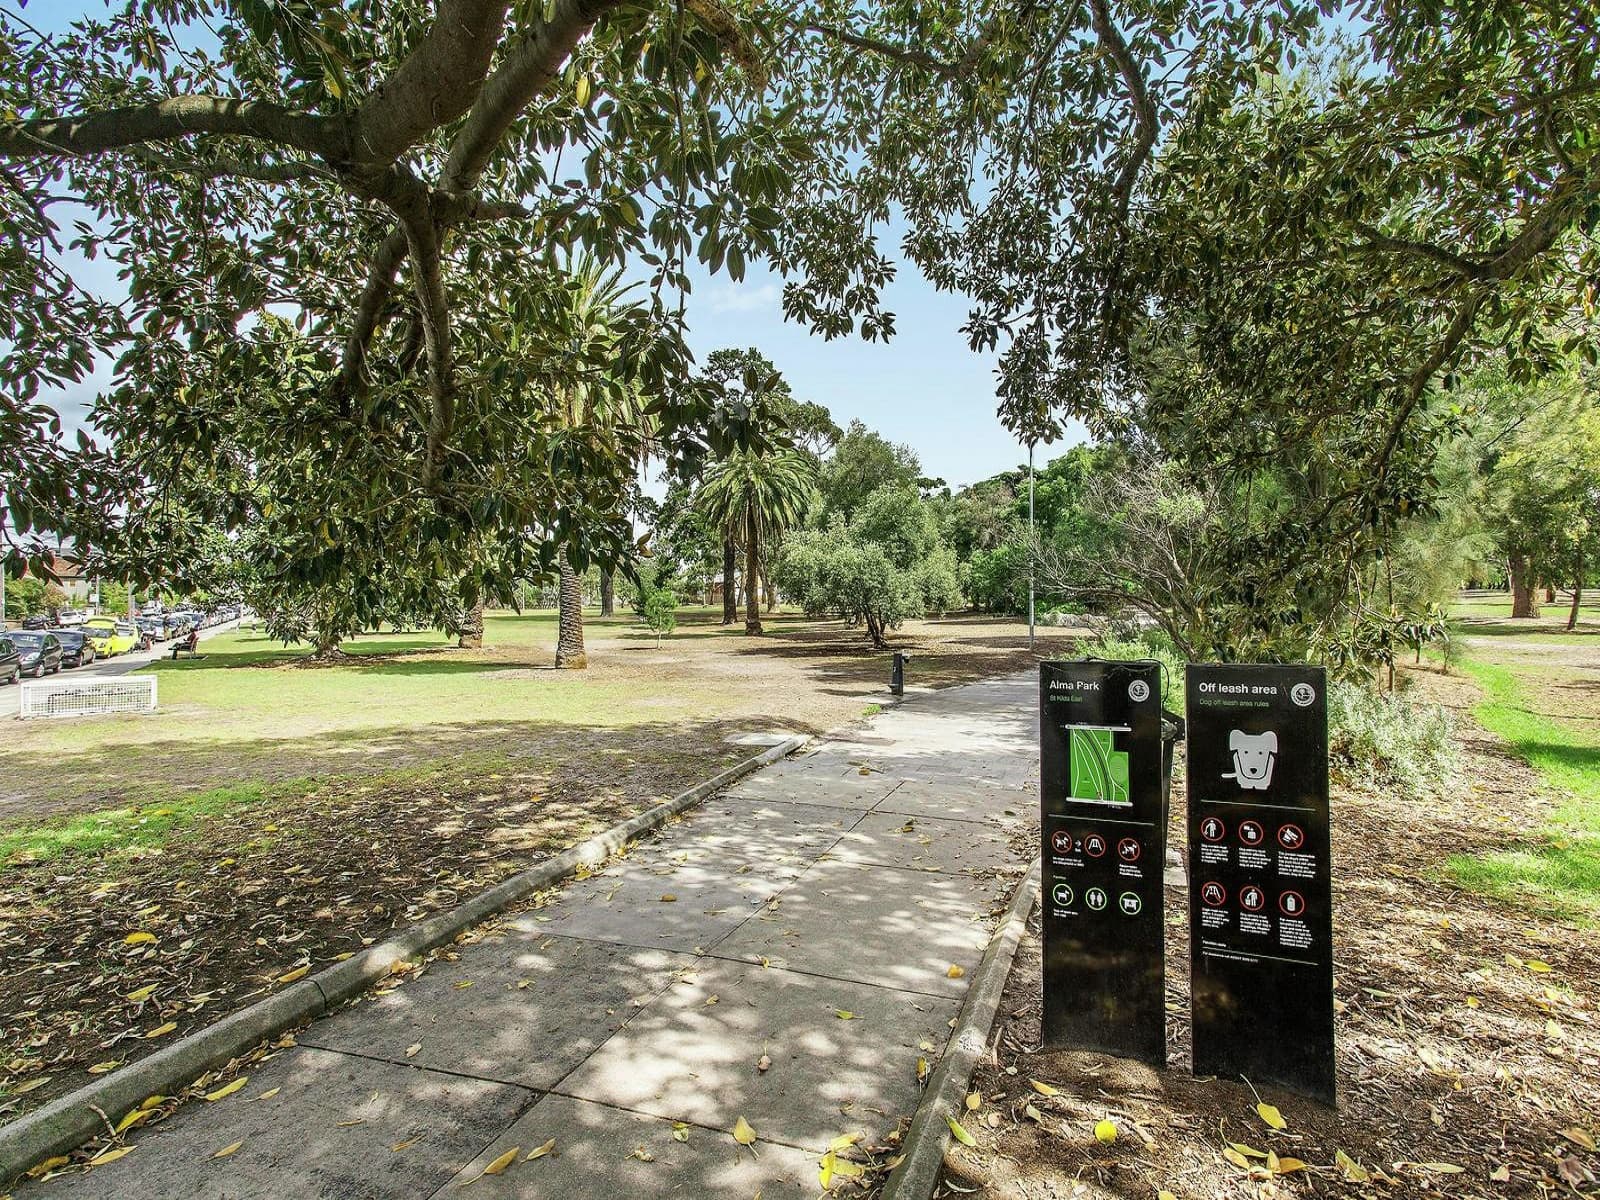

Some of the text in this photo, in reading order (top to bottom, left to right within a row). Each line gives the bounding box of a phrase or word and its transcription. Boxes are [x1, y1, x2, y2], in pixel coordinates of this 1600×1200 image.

[1049, 679, 1100, 691] Alma Park
[1199, 682, 1217, 693] Off
[1218, 683, 1249, 694] leash
[1251, 686, 1277, 695] area
[1199, 698, 1212, 706] Dog
[1254, 700, 1270, 708] rules
